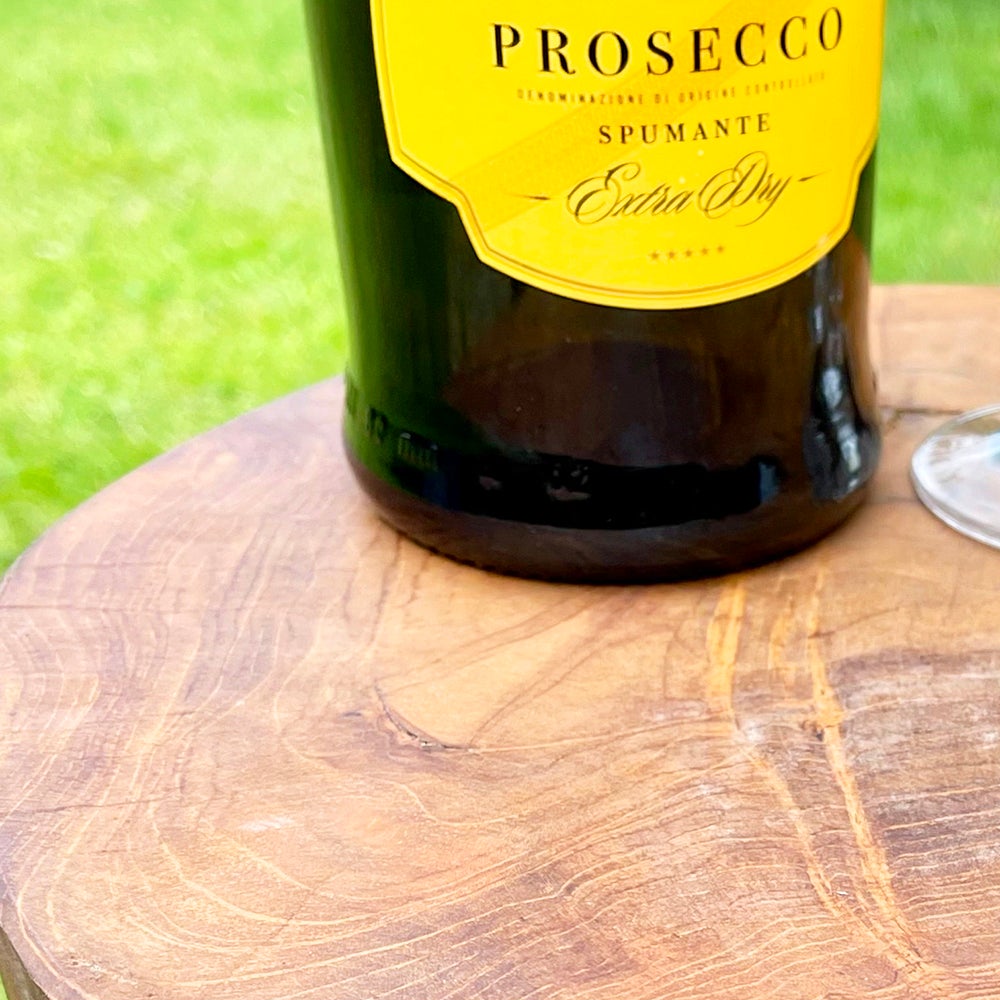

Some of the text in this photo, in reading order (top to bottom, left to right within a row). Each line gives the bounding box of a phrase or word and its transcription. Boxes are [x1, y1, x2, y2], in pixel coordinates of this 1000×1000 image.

[490, 6, 844, 77] PROSECCO
[598, 112, 771, 145] SPUMANTE
[566, 150, 794, 228] Extra Dry
